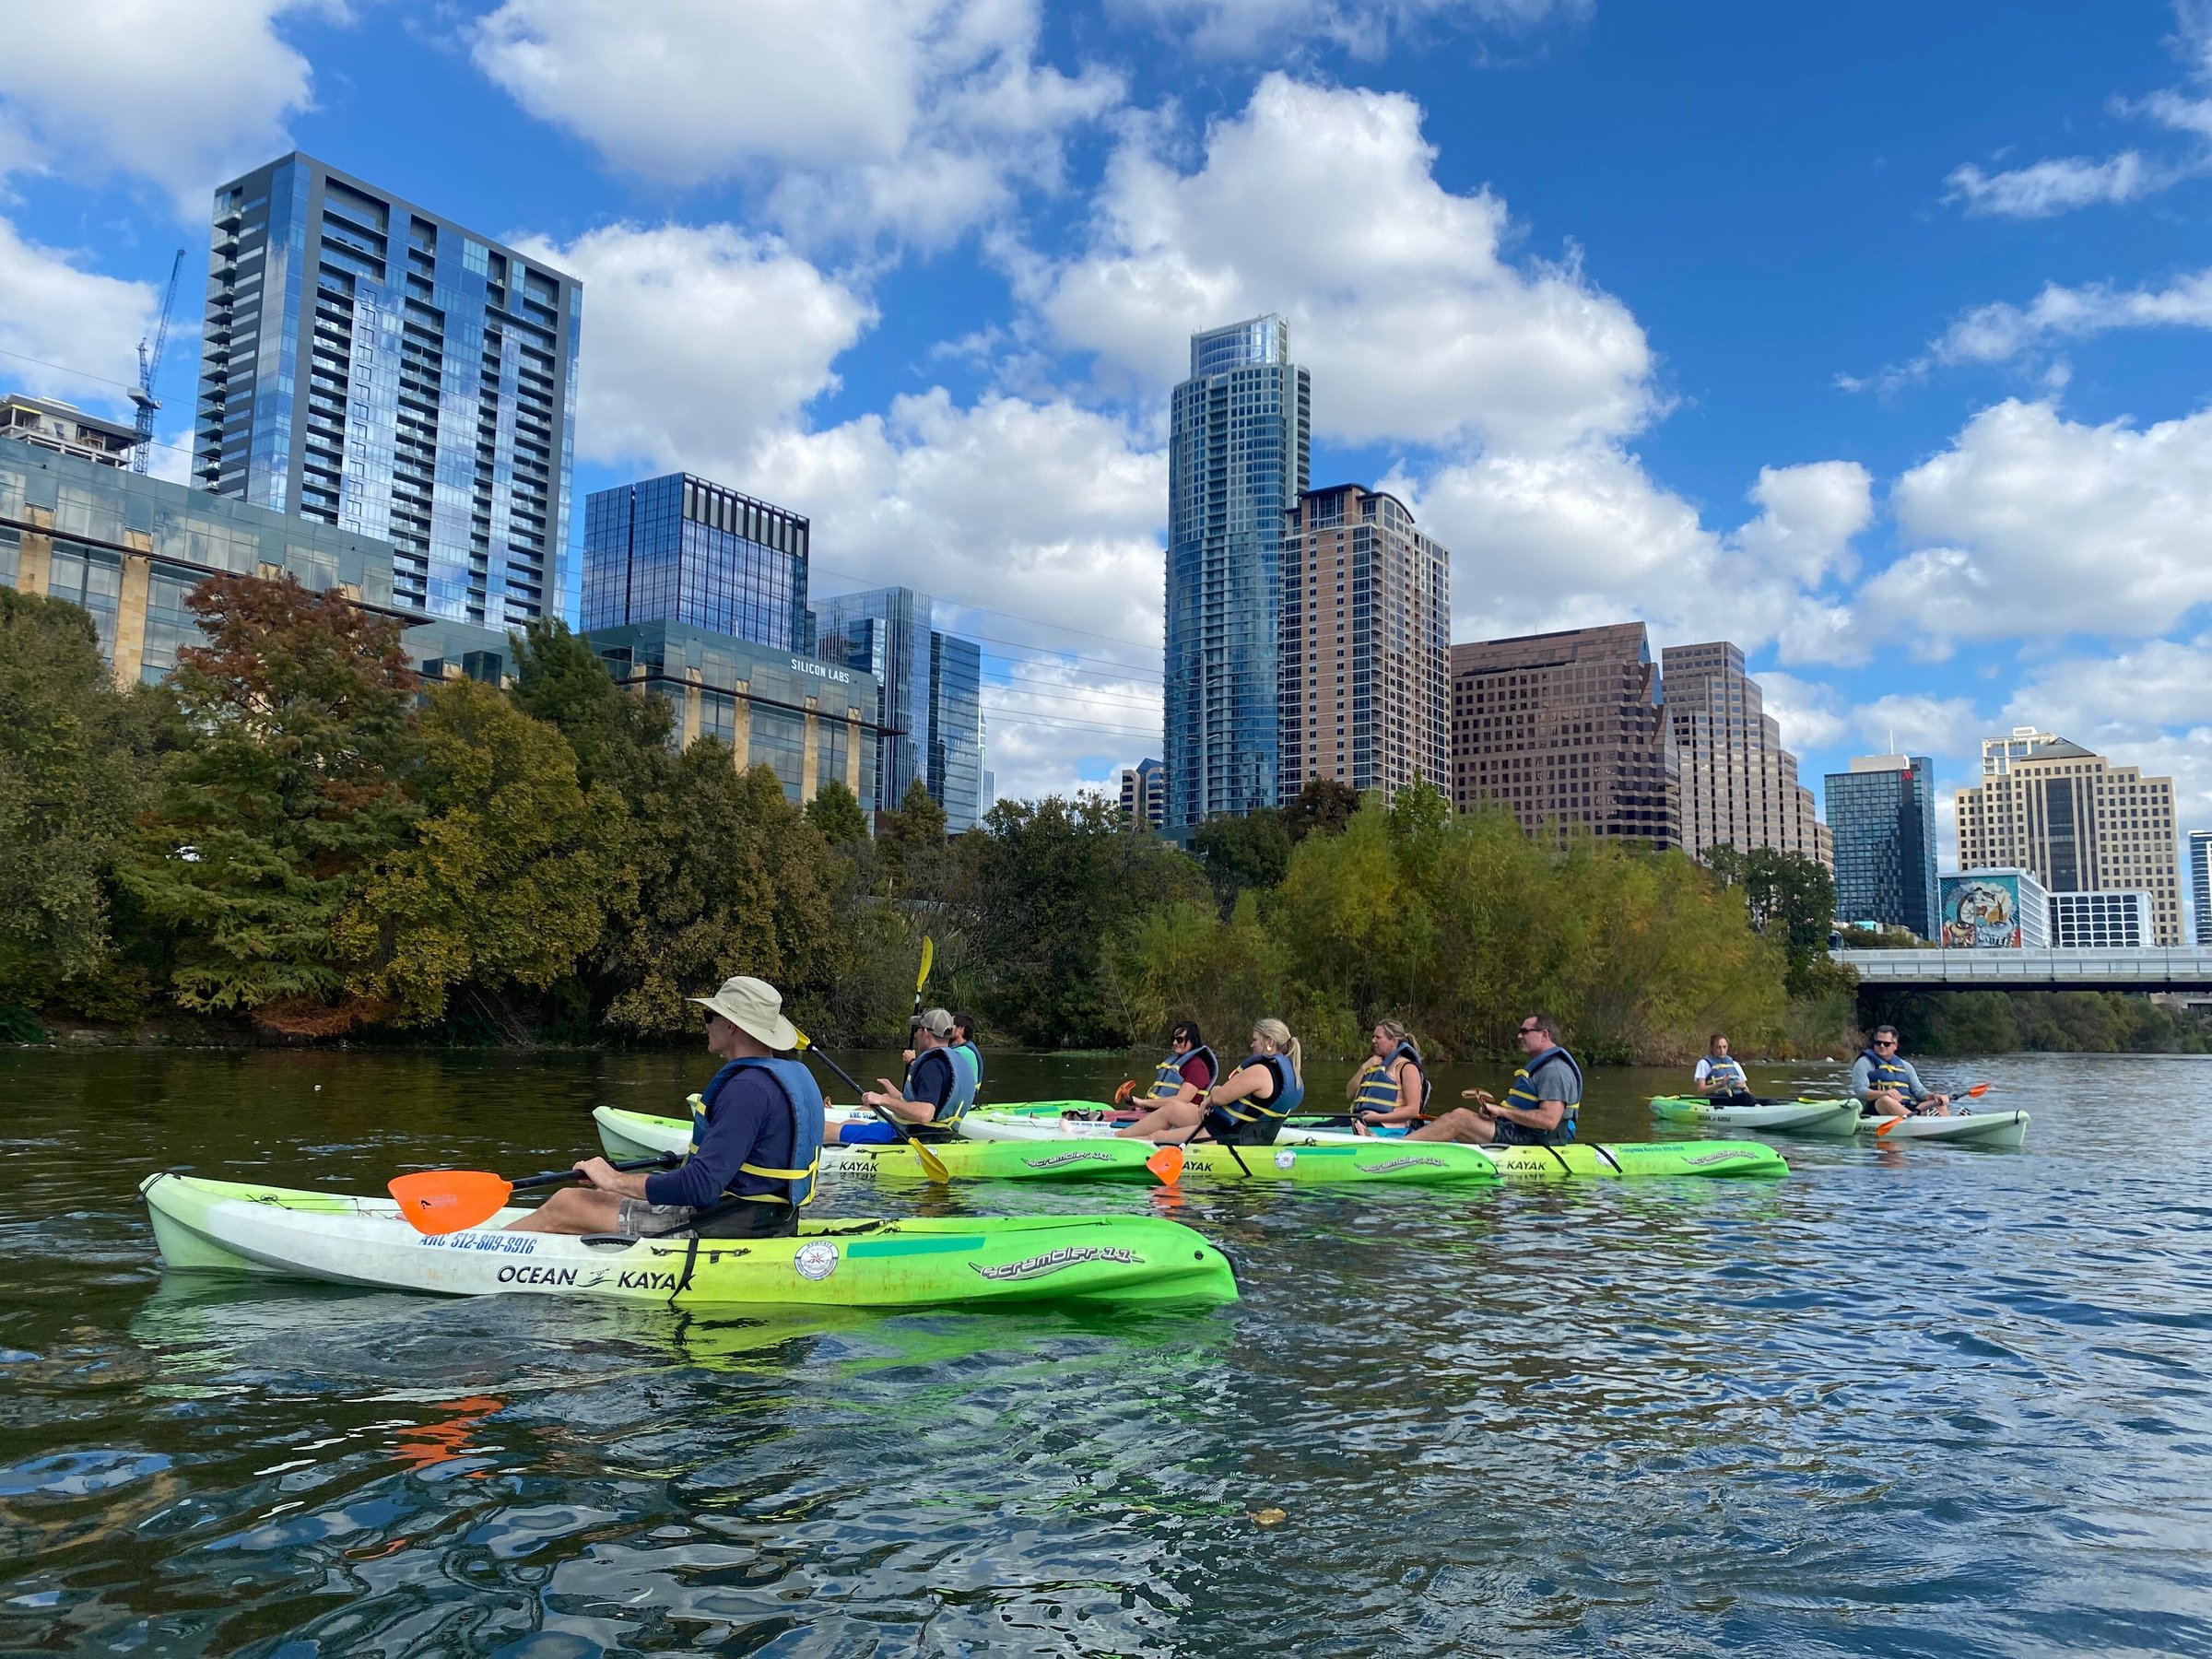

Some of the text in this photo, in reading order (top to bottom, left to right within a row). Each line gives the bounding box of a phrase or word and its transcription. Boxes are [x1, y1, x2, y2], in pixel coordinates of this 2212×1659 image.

[791, 658, 850, 684] SILICON LABS
[840, 1161, 879, 1172] KAYAK
[1182, 1160, 1214, 1172] AYAK
[1506, 1160, 1547, 1171] KAYAK
[449, 1232, 537, 1254] 512-809-8916
[497, 1265, 697, 1291] OCEAN KAYAK
